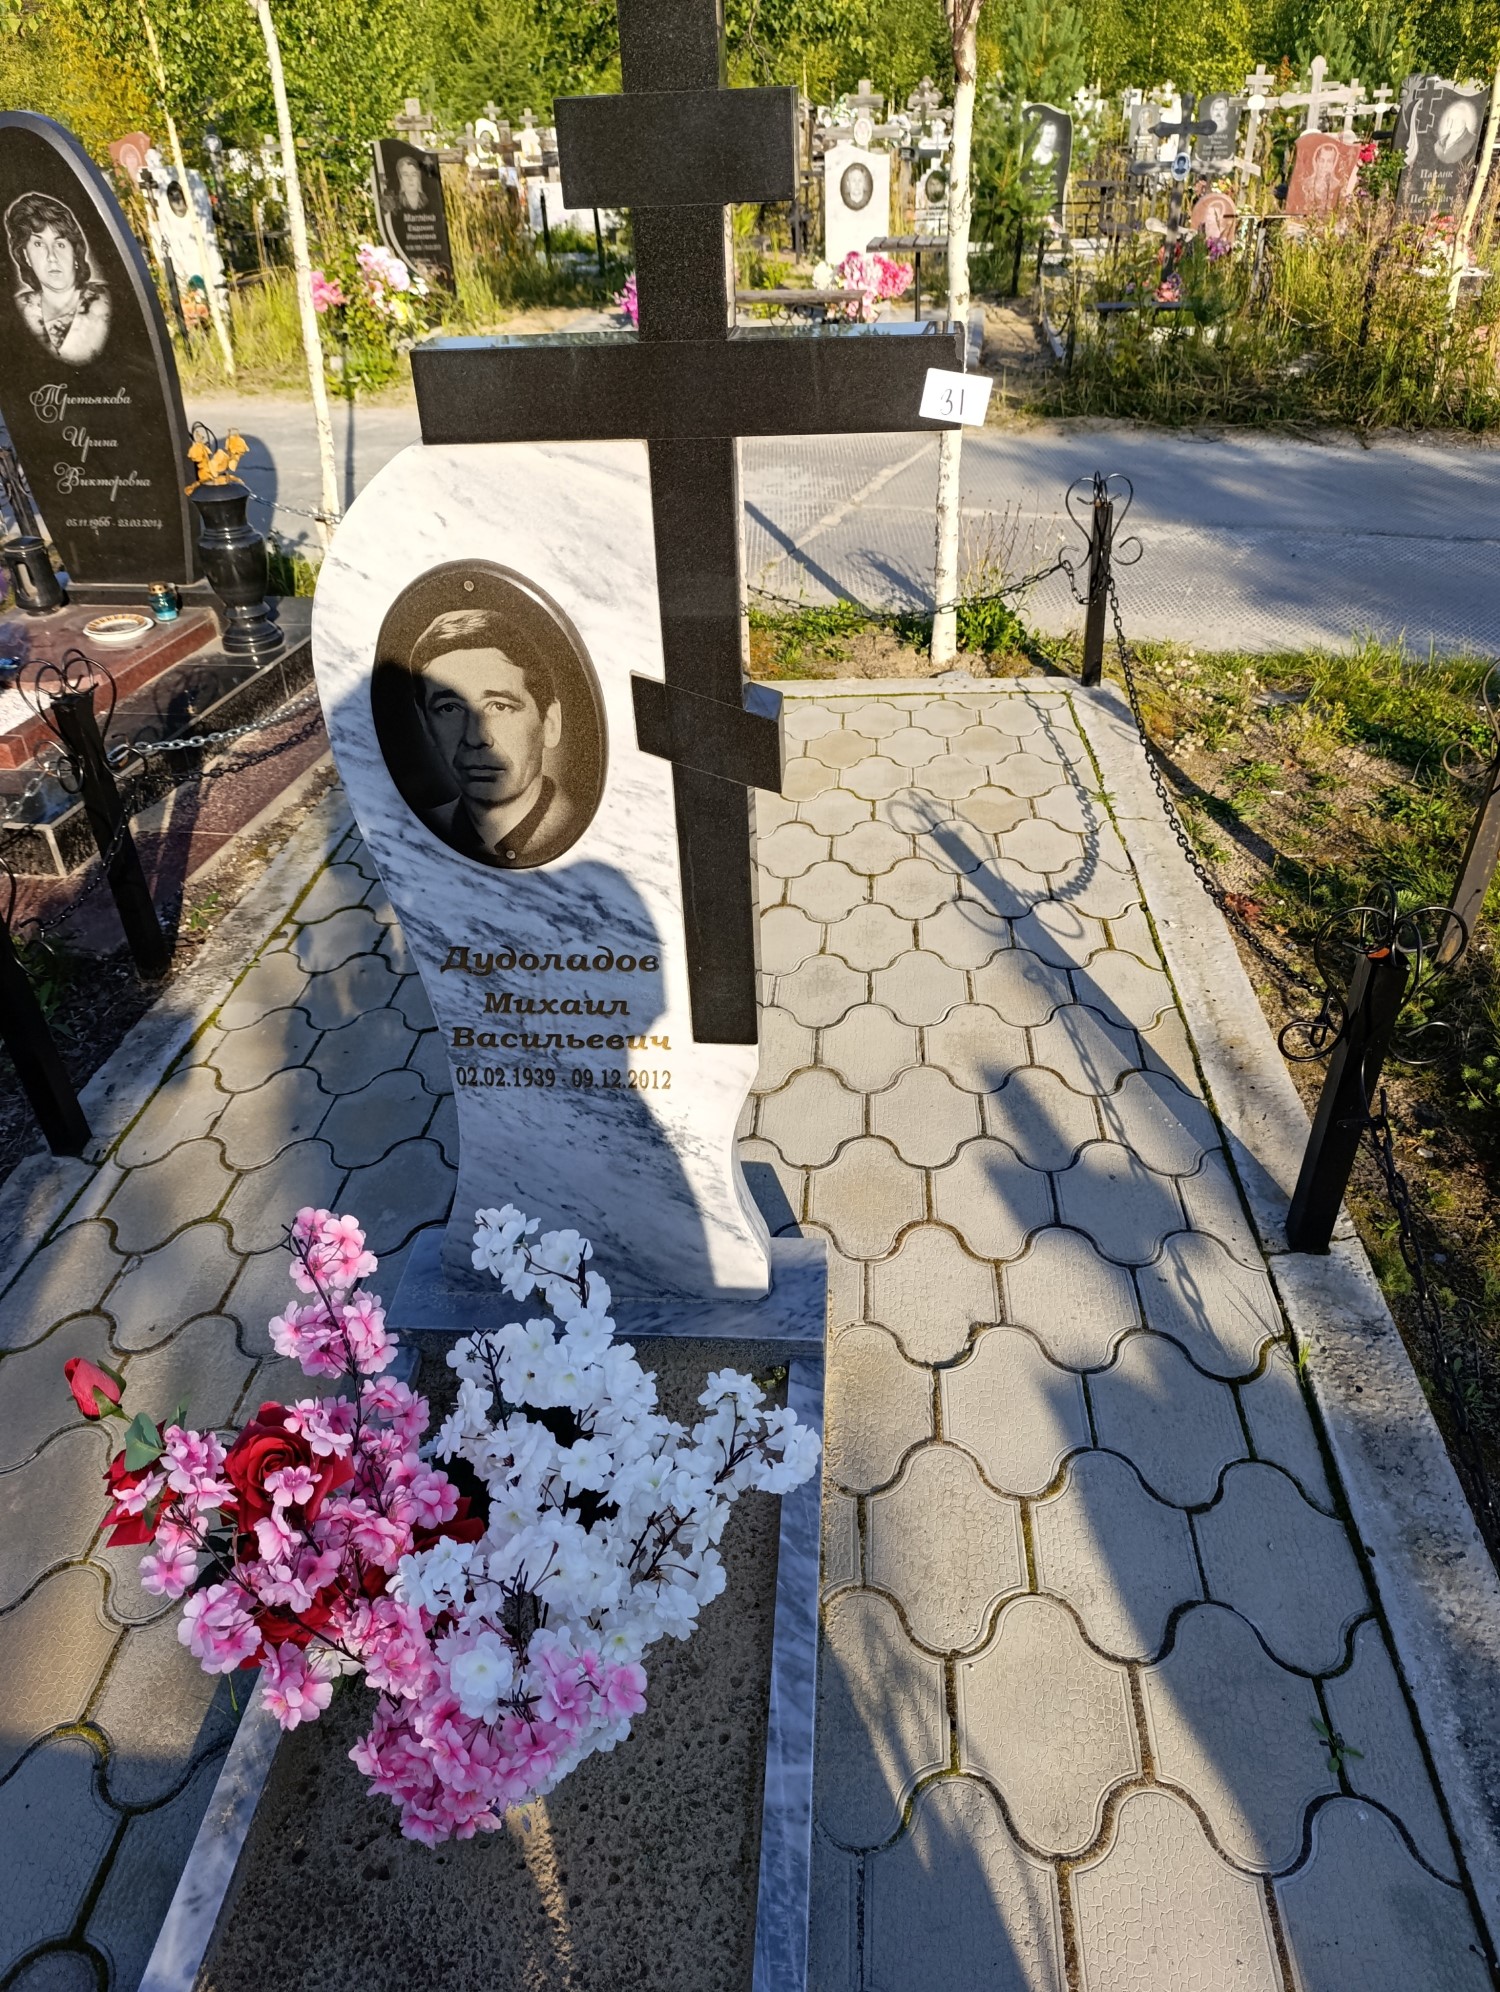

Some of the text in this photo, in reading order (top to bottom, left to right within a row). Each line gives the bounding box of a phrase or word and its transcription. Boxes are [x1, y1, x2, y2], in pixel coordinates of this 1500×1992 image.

[29, 383, 132, 423] Третьякова
[940, 389, 964, 415] 31
[62, 426, 118, 463] Ирина
[53, 462, 151, 502] Викторовна
[440, 945, 660, 976] Дудоладов
[483, 992, 630, 1015] Михаил
[451, 1027, 672, 1050] Васильевич
[456, 1066, 556, 1087] 02.02.1939
[571, 1068, 672, 1089] 09.12.2012
